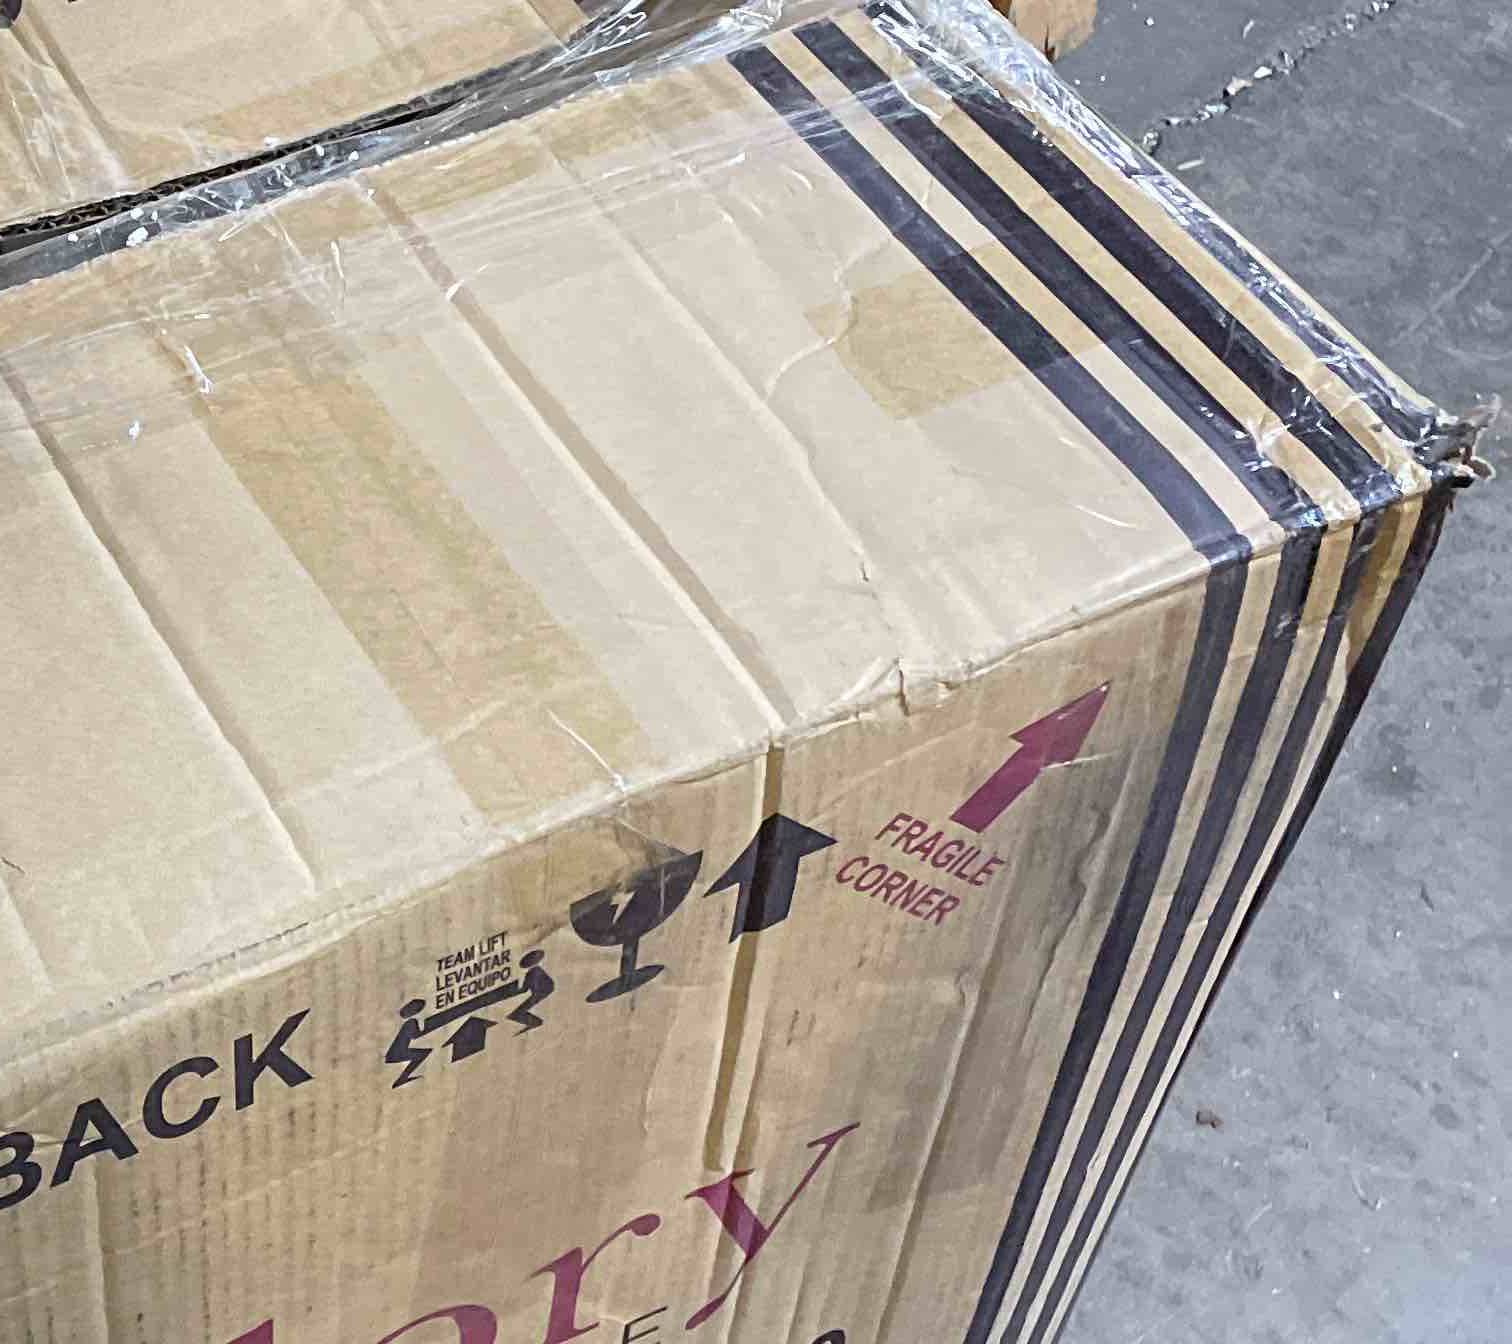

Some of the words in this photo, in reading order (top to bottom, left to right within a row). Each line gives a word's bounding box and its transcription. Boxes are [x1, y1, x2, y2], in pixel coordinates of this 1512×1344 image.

[875, 812, 1006, 886] FRAGILE
[836, 856, 960, 926] CORNER
[436, 945, 475, 972] TEAM
[479, 930, 508, 956] LIFT
[436, 949, 511, 992] LEVANTAR
[435, 990, 455, 1009] EN
[458, 967, 511, 1000] EQUIPO
